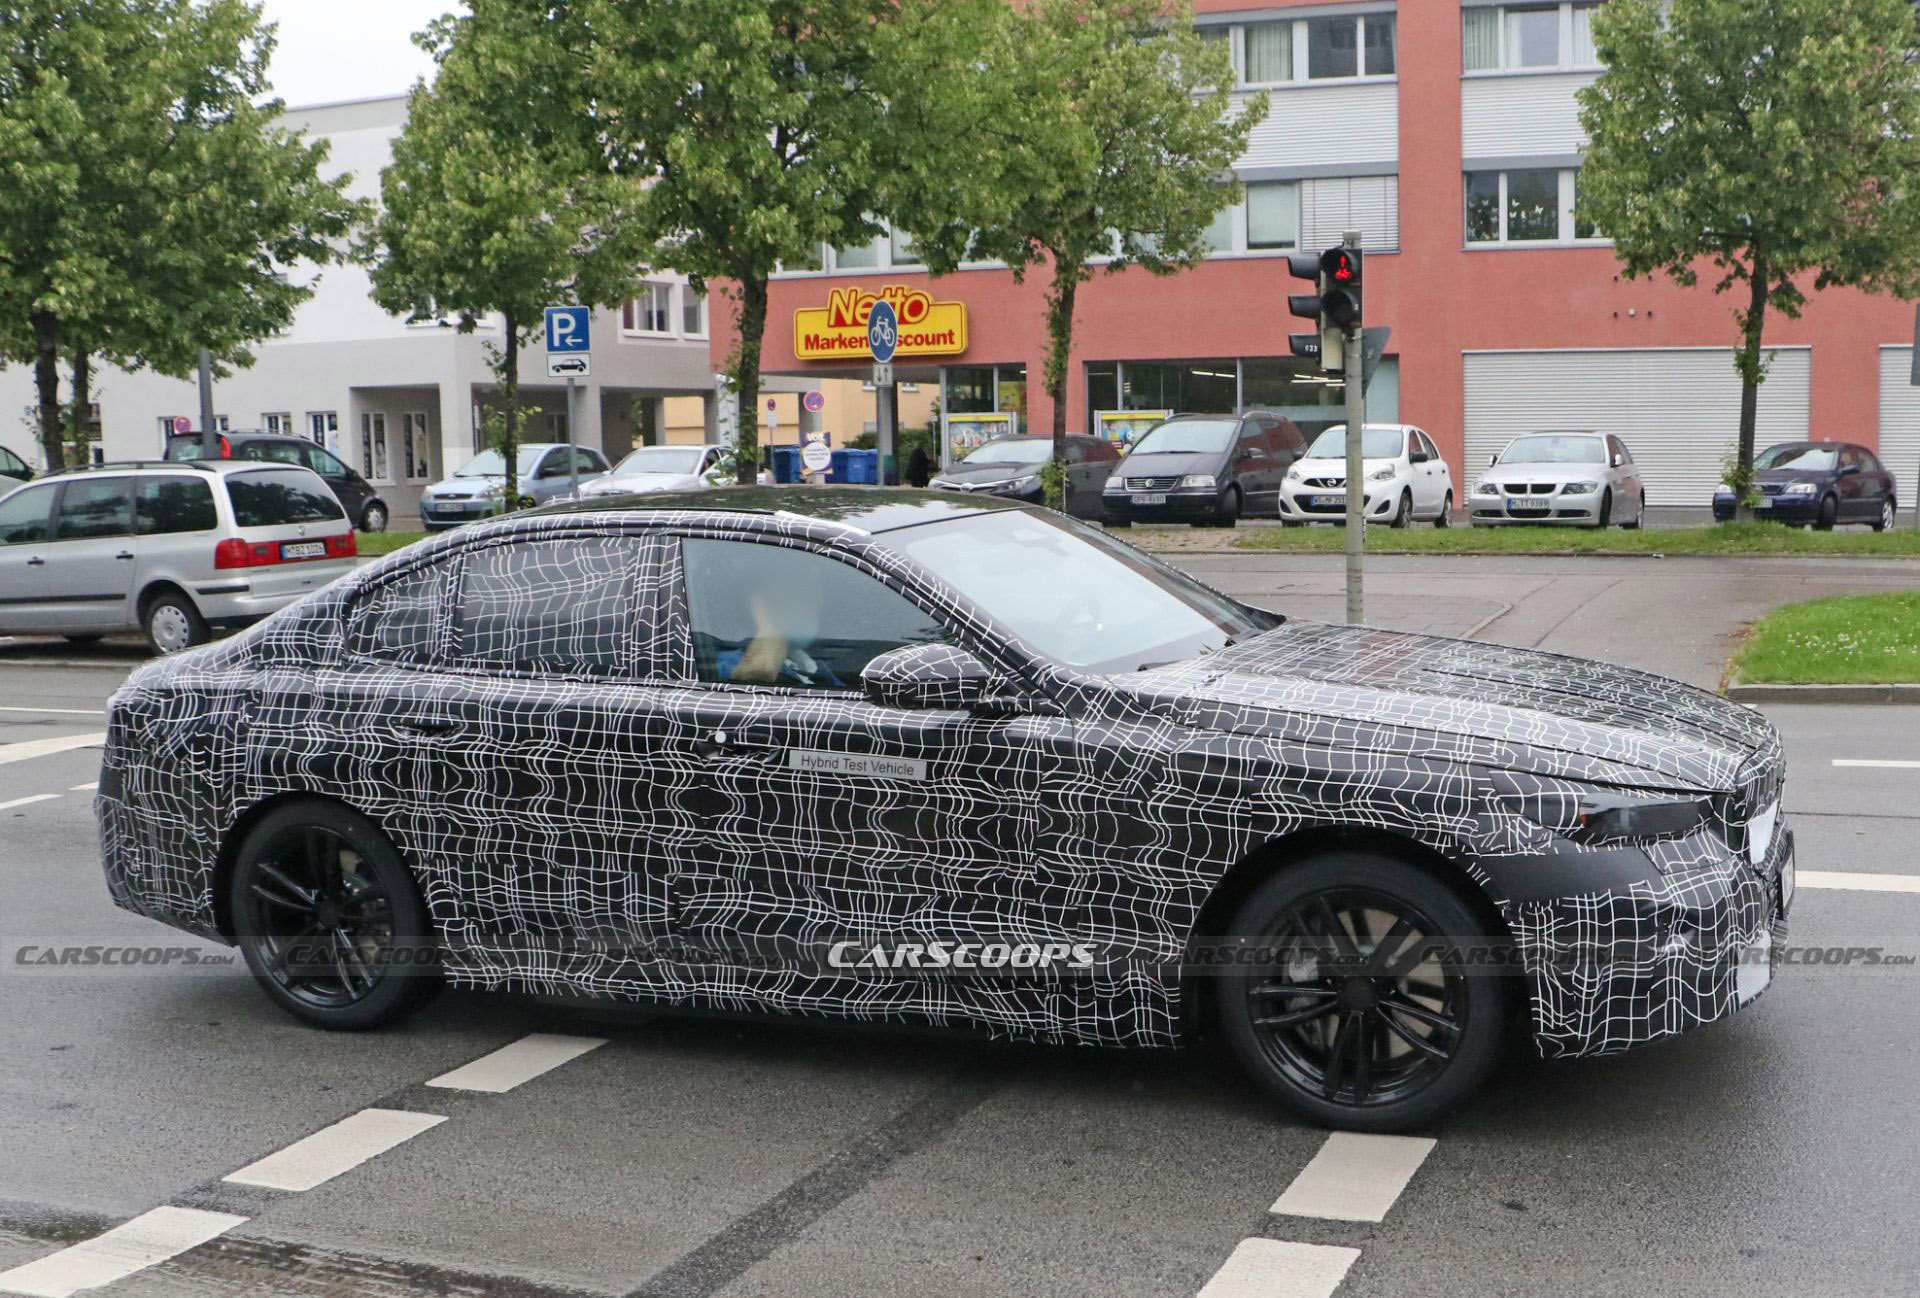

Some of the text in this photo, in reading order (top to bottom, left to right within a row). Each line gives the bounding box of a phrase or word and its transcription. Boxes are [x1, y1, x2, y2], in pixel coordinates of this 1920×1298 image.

[552, 313, 576, 347] P
[801, 755, 915, 776] Hybrid Test Vehicle
